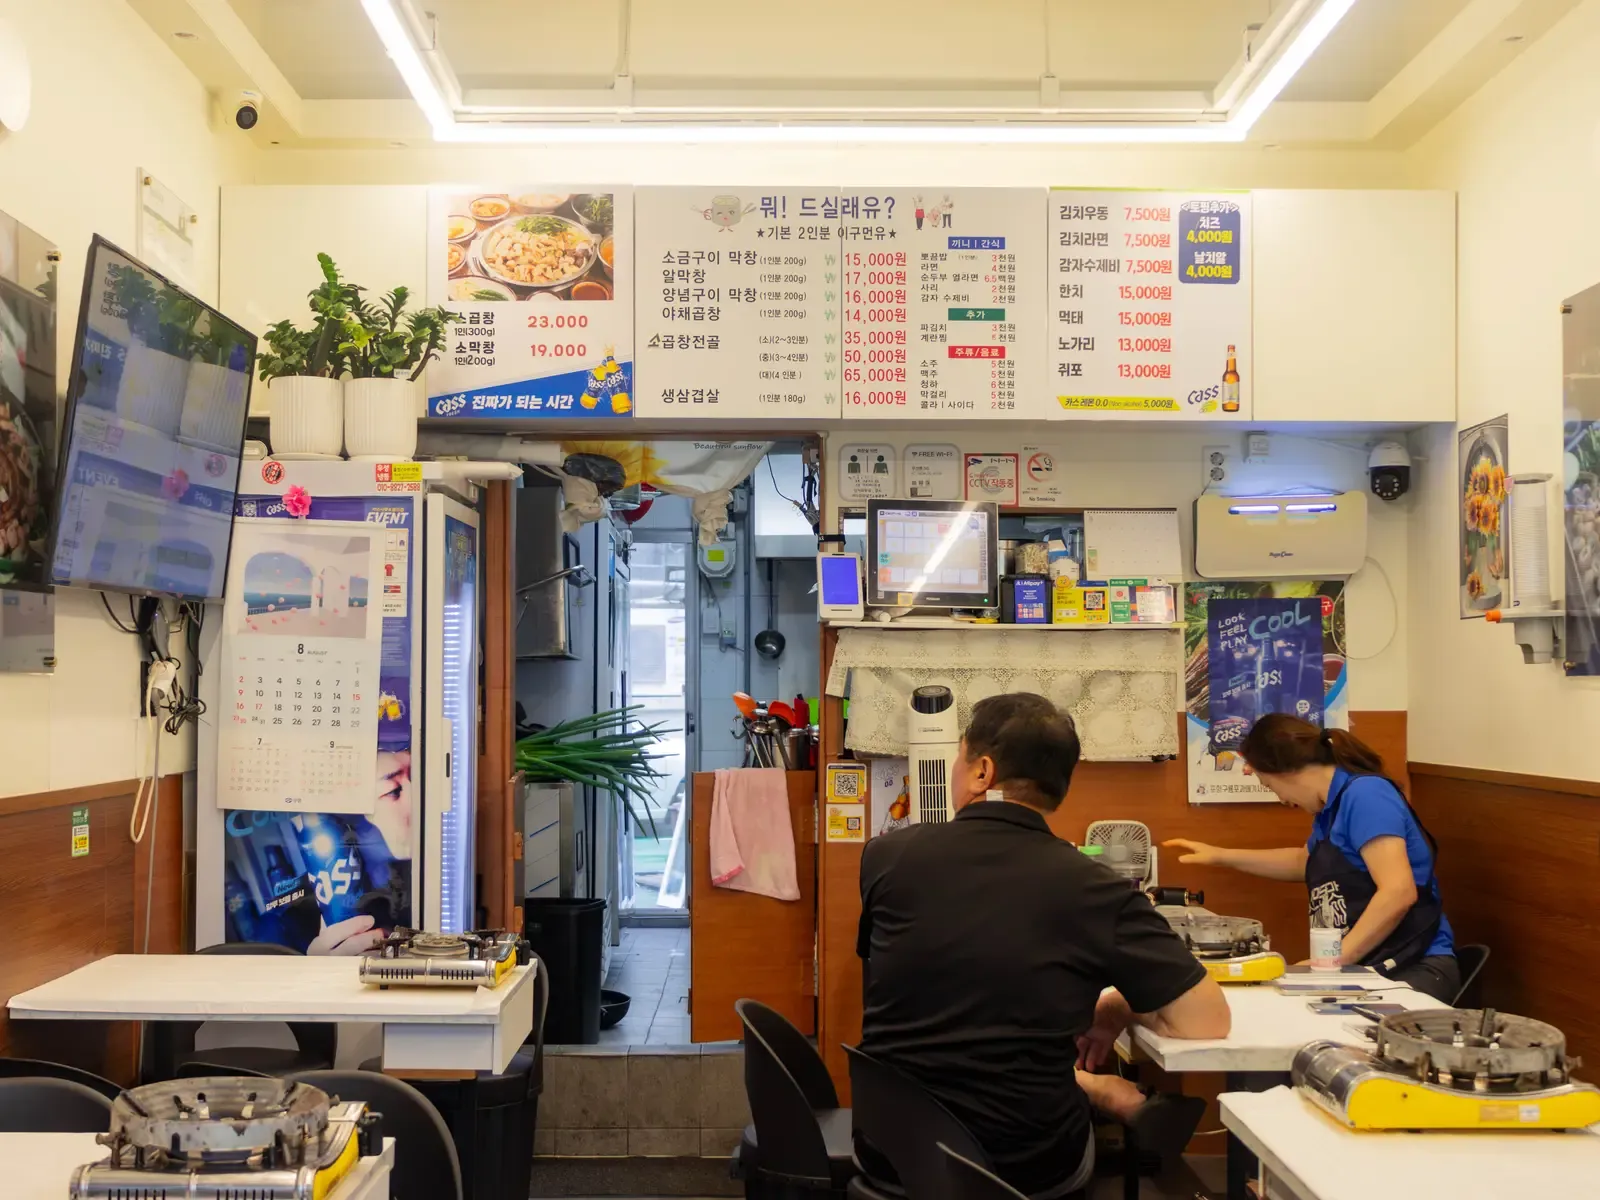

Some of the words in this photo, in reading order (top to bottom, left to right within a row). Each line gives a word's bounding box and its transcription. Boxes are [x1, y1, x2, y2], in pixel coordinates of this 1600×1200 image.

[759, 196, 786, 219] 뭐!
[798, 196, 896, 220] 드실래유?
[1059, 206, 1108, 221] 김치우동
[1123, 207, 1171, 222] 7,500원
[1199, 216, 1221, 229] 치즈
[767, 226, 792, 240] 기본
[798, 226, 831, 241] 2인분
[1059, 232, 1109, 247] 김치라면
[1123, 233, 1171, 248] 7,500원
[1186, 230, 1233, 244] 4,000원
[951, 239, 970, 248] 끼니
[981, 239, 1000, 249] 간식
[662, 250, 720, 266] 소금구이
[728, 251, 758, 266] 막창
[759, 257, 781, 265] (1인분
[784, 257, 807, 266] 200g)
[844, 252, 907, 268] 15,000원
[1194, 251, 1227, 265] 날치알
[920, 263, 938, 272] 라면
[1059, 258, 1120, 274] 감자수제비
[1126, 259, 1173, 275] 7,500원
[1186, 265, 1233, 278] 4,000원
[662, 269, 706, 284] 알막창
[759, 274, 781, 283] (1인분
[784, 274, 807, 284] 200g)
[844, 271, 907, 287] 17,000원
[920, 273, 948, 282] 순두부
[920, 283, 938, 292] 사리
[1059, 284, 1083, 299] 한치
[1118, 285, 1172, 301] 15,000원
[662, 288, 720, 303] 양념구이
[728, 288, 758, 303] 막창
[759, 292, 781, 301] (1인분
[784, 292, 807, 302] 200g)
[844, 289, 907, 305] 16,000원
[921, 294, 938, 303] 감자
[943, 294, 970, 303] 수제비
[527, 315, 589, 329] 23,000
[662, 306, 721, 321] 야채곱창
[759, 310, 781, 318] (1인분
[784, 310, 807, 319] 200g)
[844, 308, 907, 324] 14,000원
[966, 310, 986, 320] 추가
[1059, 311, 1084, 326] 먹태
[1118, 312, 1172, 327] 15,000원
[454, 328, 495, 337] 1인(300g)
[920, 323, 947, 332] 파김치
[648, 333, 720, 350] 소곱창전골
[844, 330, 907, 347] 35,000원
[921, 333, 947, 343] 계란찜
[1058, 337, 1095, 351] 노가리
[1118, 337, 1171, 353] 13,000원
[455, 341, 495, 355] 소막창
[530, 343, 587, 358] 19,000
[454, 355, 495, 367] 1인(200g)
[844, 349, 907, 365] 50,000원
[920, 359, 938, 368] 소주
[844, 367, 907, 384] 65,000원
[920, 369, 938, 379] 맥주
[1058, 363, 1083, 378] 쥐포
[1117, 363, 1171, 379] 13,000원
[920, 380, 938, 389] 청하
[661, 389, 720, 404] 생삼겹살
[759, 394, 781, 403] (1인분
[783, 394, 806, 404] 180g)
[844, 391, 907, 407] 16,000원
[920, 390, 947, 399] 막걸리
[472, 395, 513, 410] 진짜가
[515, 395, 543, 410] 되는
[546, 395, 574, 410] 시간
[920, 400, 938, 410] 콜라
[948, 400, 974, 410] 사이다
[1065, 398, 1080, 407] 카스
[1080, 398, 1095, 407] 레몬
[1143, 399, 1174, 409] 5,000원
[366, 512, 410, 524] EVENT
[1218, 612, 1246, 629] LOOK
[1248, 600, 1312, 641] COOL
[1219, 623, 1248, 641] FEEL
[297, 643, 304, 655] 8
[1220, 634, 1249, 652] PLAY
[257, 676, 263, 684] 3
[296, 677, 302, 685] 5
[315, 677, 321, 686] 6
[335, 679, 341, 687] 7
[255, 689, 264, 697] 10
[275, 690, 282, 698] 11
[294, 691, 303, 699] 12
[313, 692, 322, 700] 13
[332, 692, 341, 700] 14
[352, 693, 361, 701] 15
[236, 702, 245, 710] 16
[273, 703, 283, 711] 18
[293, 704, 302, 712] 19
[311, 705, 322, 713] 20
[332, 706, 341, 714] 21
[272, 717, 283, 725] 25
[292, 718, 302, 726] 26
[331, 719, 341, 727] 28
[257, 737, 262, 746] 7
[329, 740, 335, 749] 9
